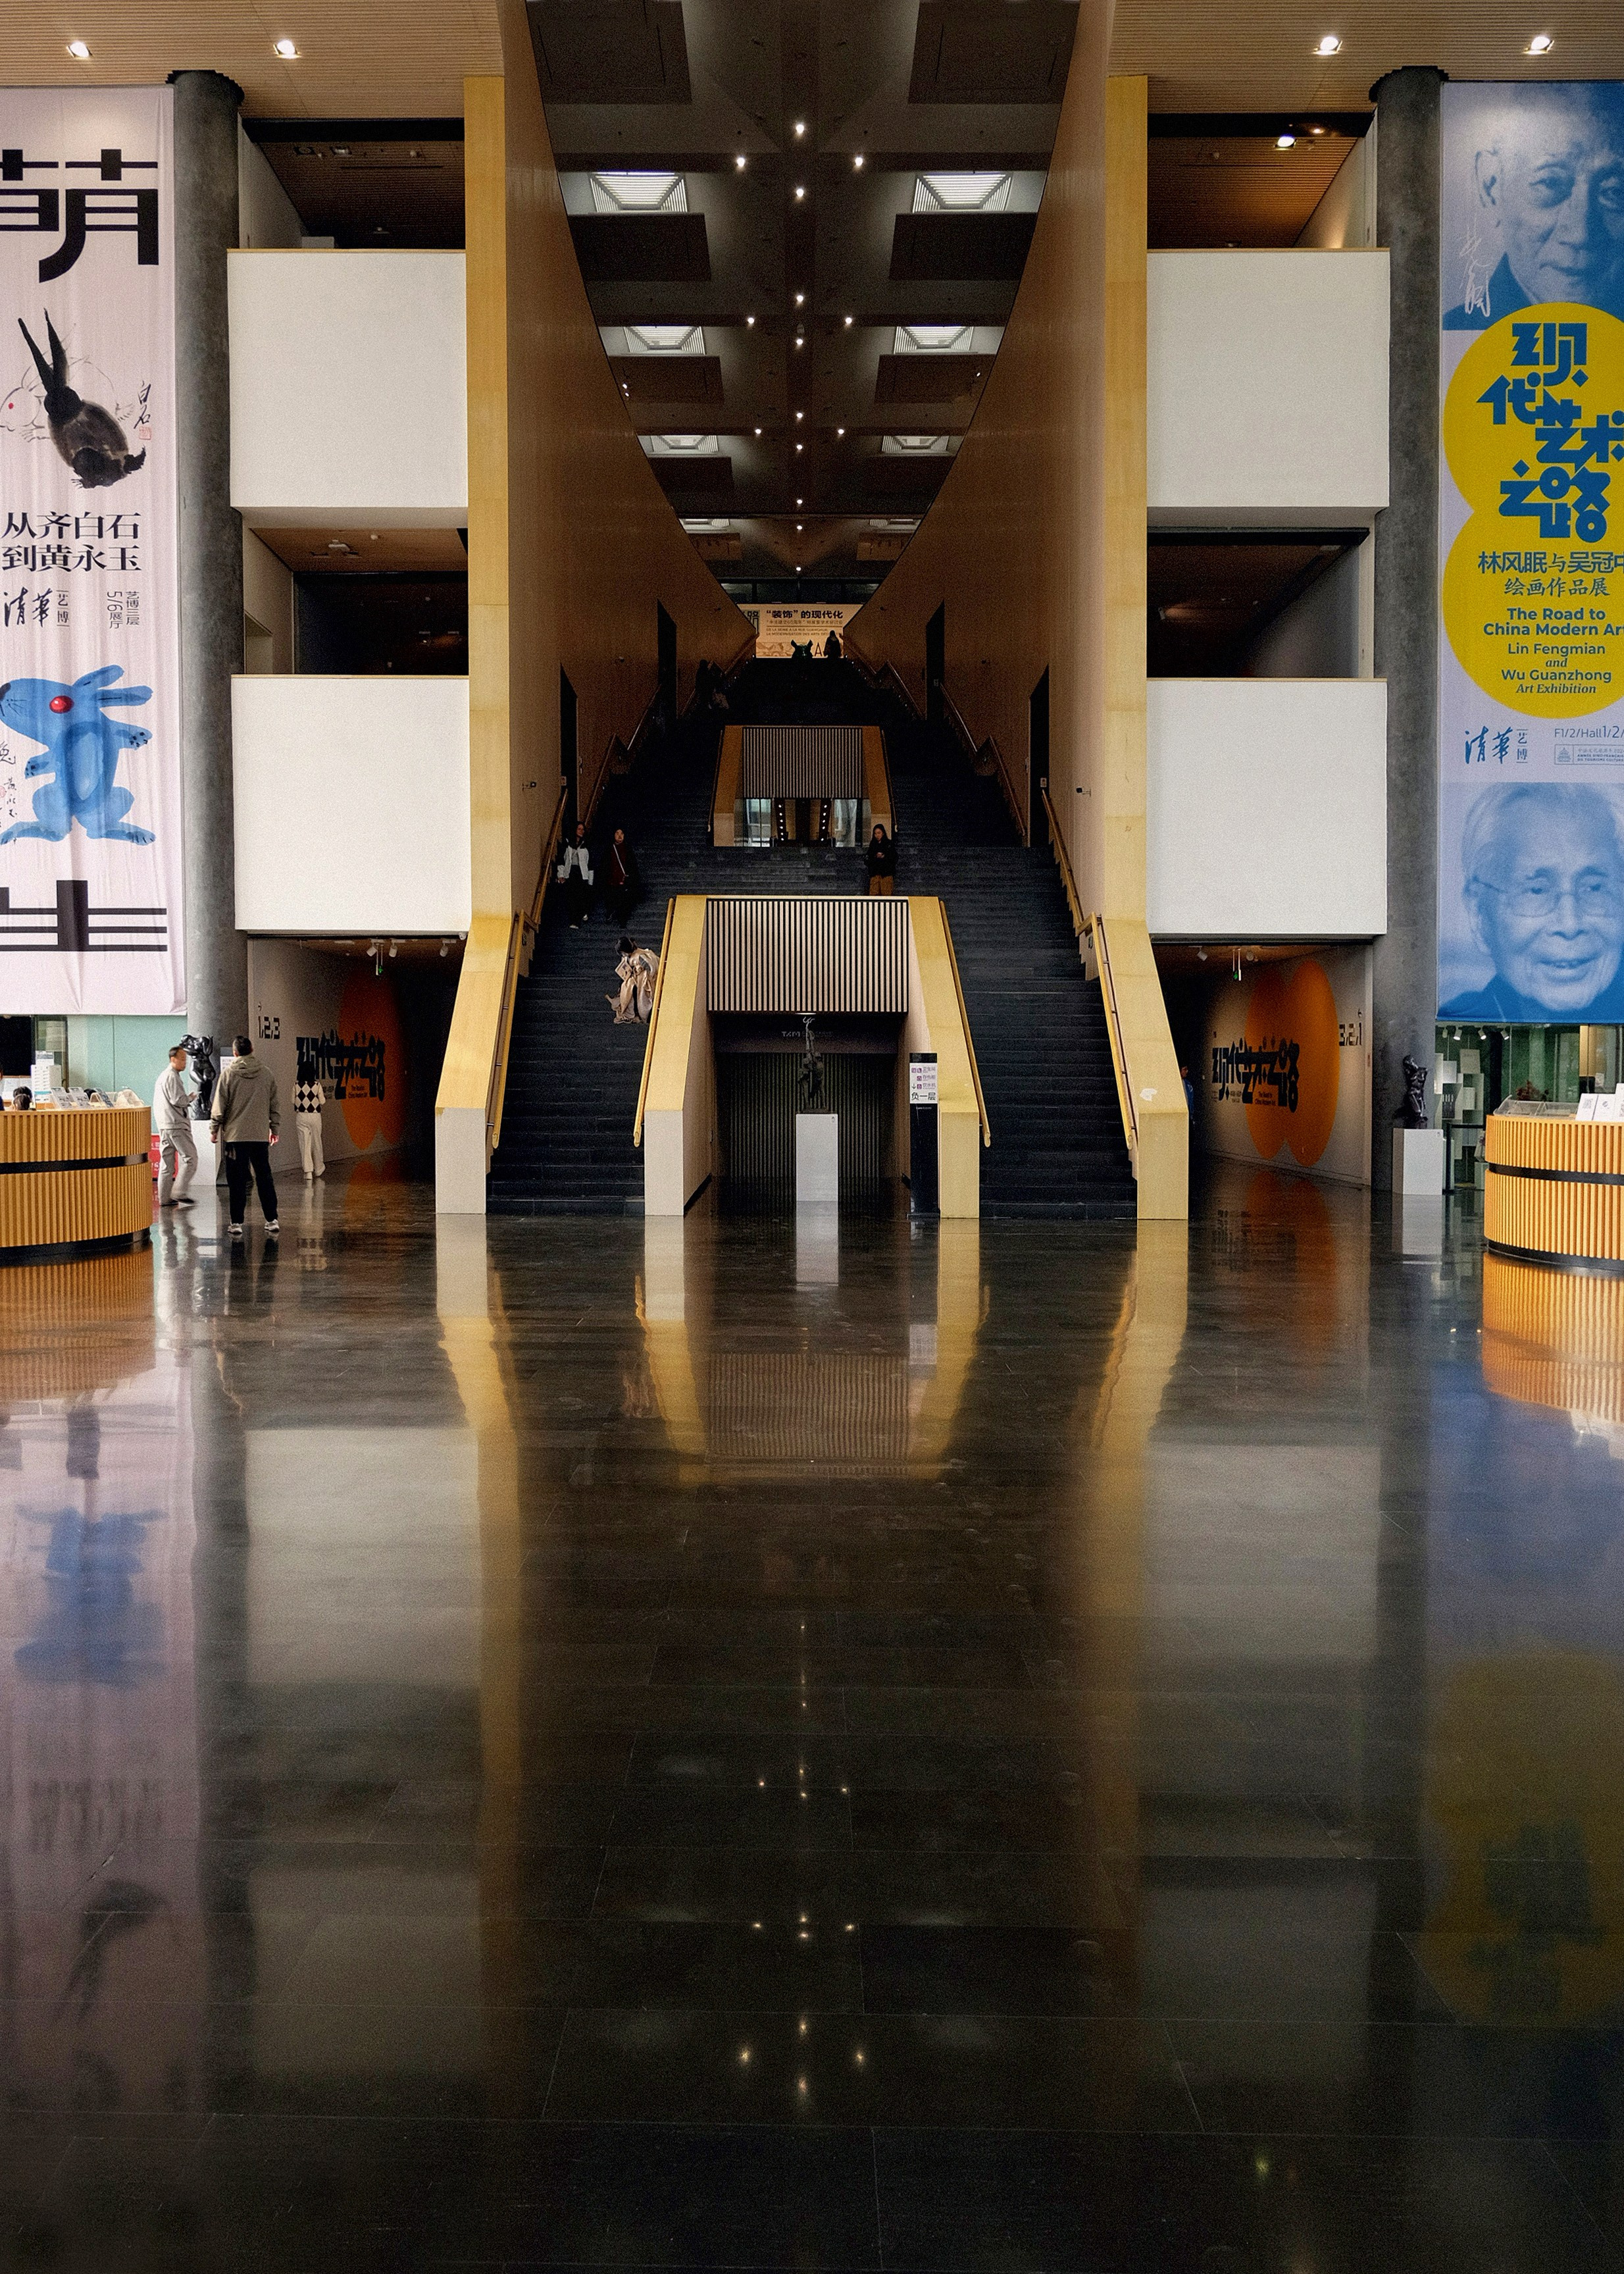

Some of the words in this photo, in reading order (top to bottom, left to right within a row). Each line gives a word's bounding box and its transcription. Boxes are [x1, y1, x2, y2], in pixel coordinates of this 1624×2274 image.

[0, 149, 159, 283] 萌
[1, 511, 141, 539] 从齐白石
[1, 544, 141, 572] 到黄永玉
[1504, 577, 1610, 598] 绘画作品展
[1507, 607, 1537, 620] The
[1543, 607, 1584, 620] Road
[1588, 608, 1606, 620] to
[1484, 622, 1530, 635] China
[1536, 623, 1598, 635] Modern
[1603, 623, 1624, 635] Ar
[1508, 642, 1529, 654] Lin
[1534, 642, 1606, 657] Fengmian
[1546, 658, 1567, 667] and
[1501, 669, 1525, 680] Wu
[1529, 669, 1611, 683] Guanzhong
[1516, 684, 1533, 694] Art
[1536, 684, 1596, 694] Exhibition
[911, 1092, 936, 1100] 负一层
